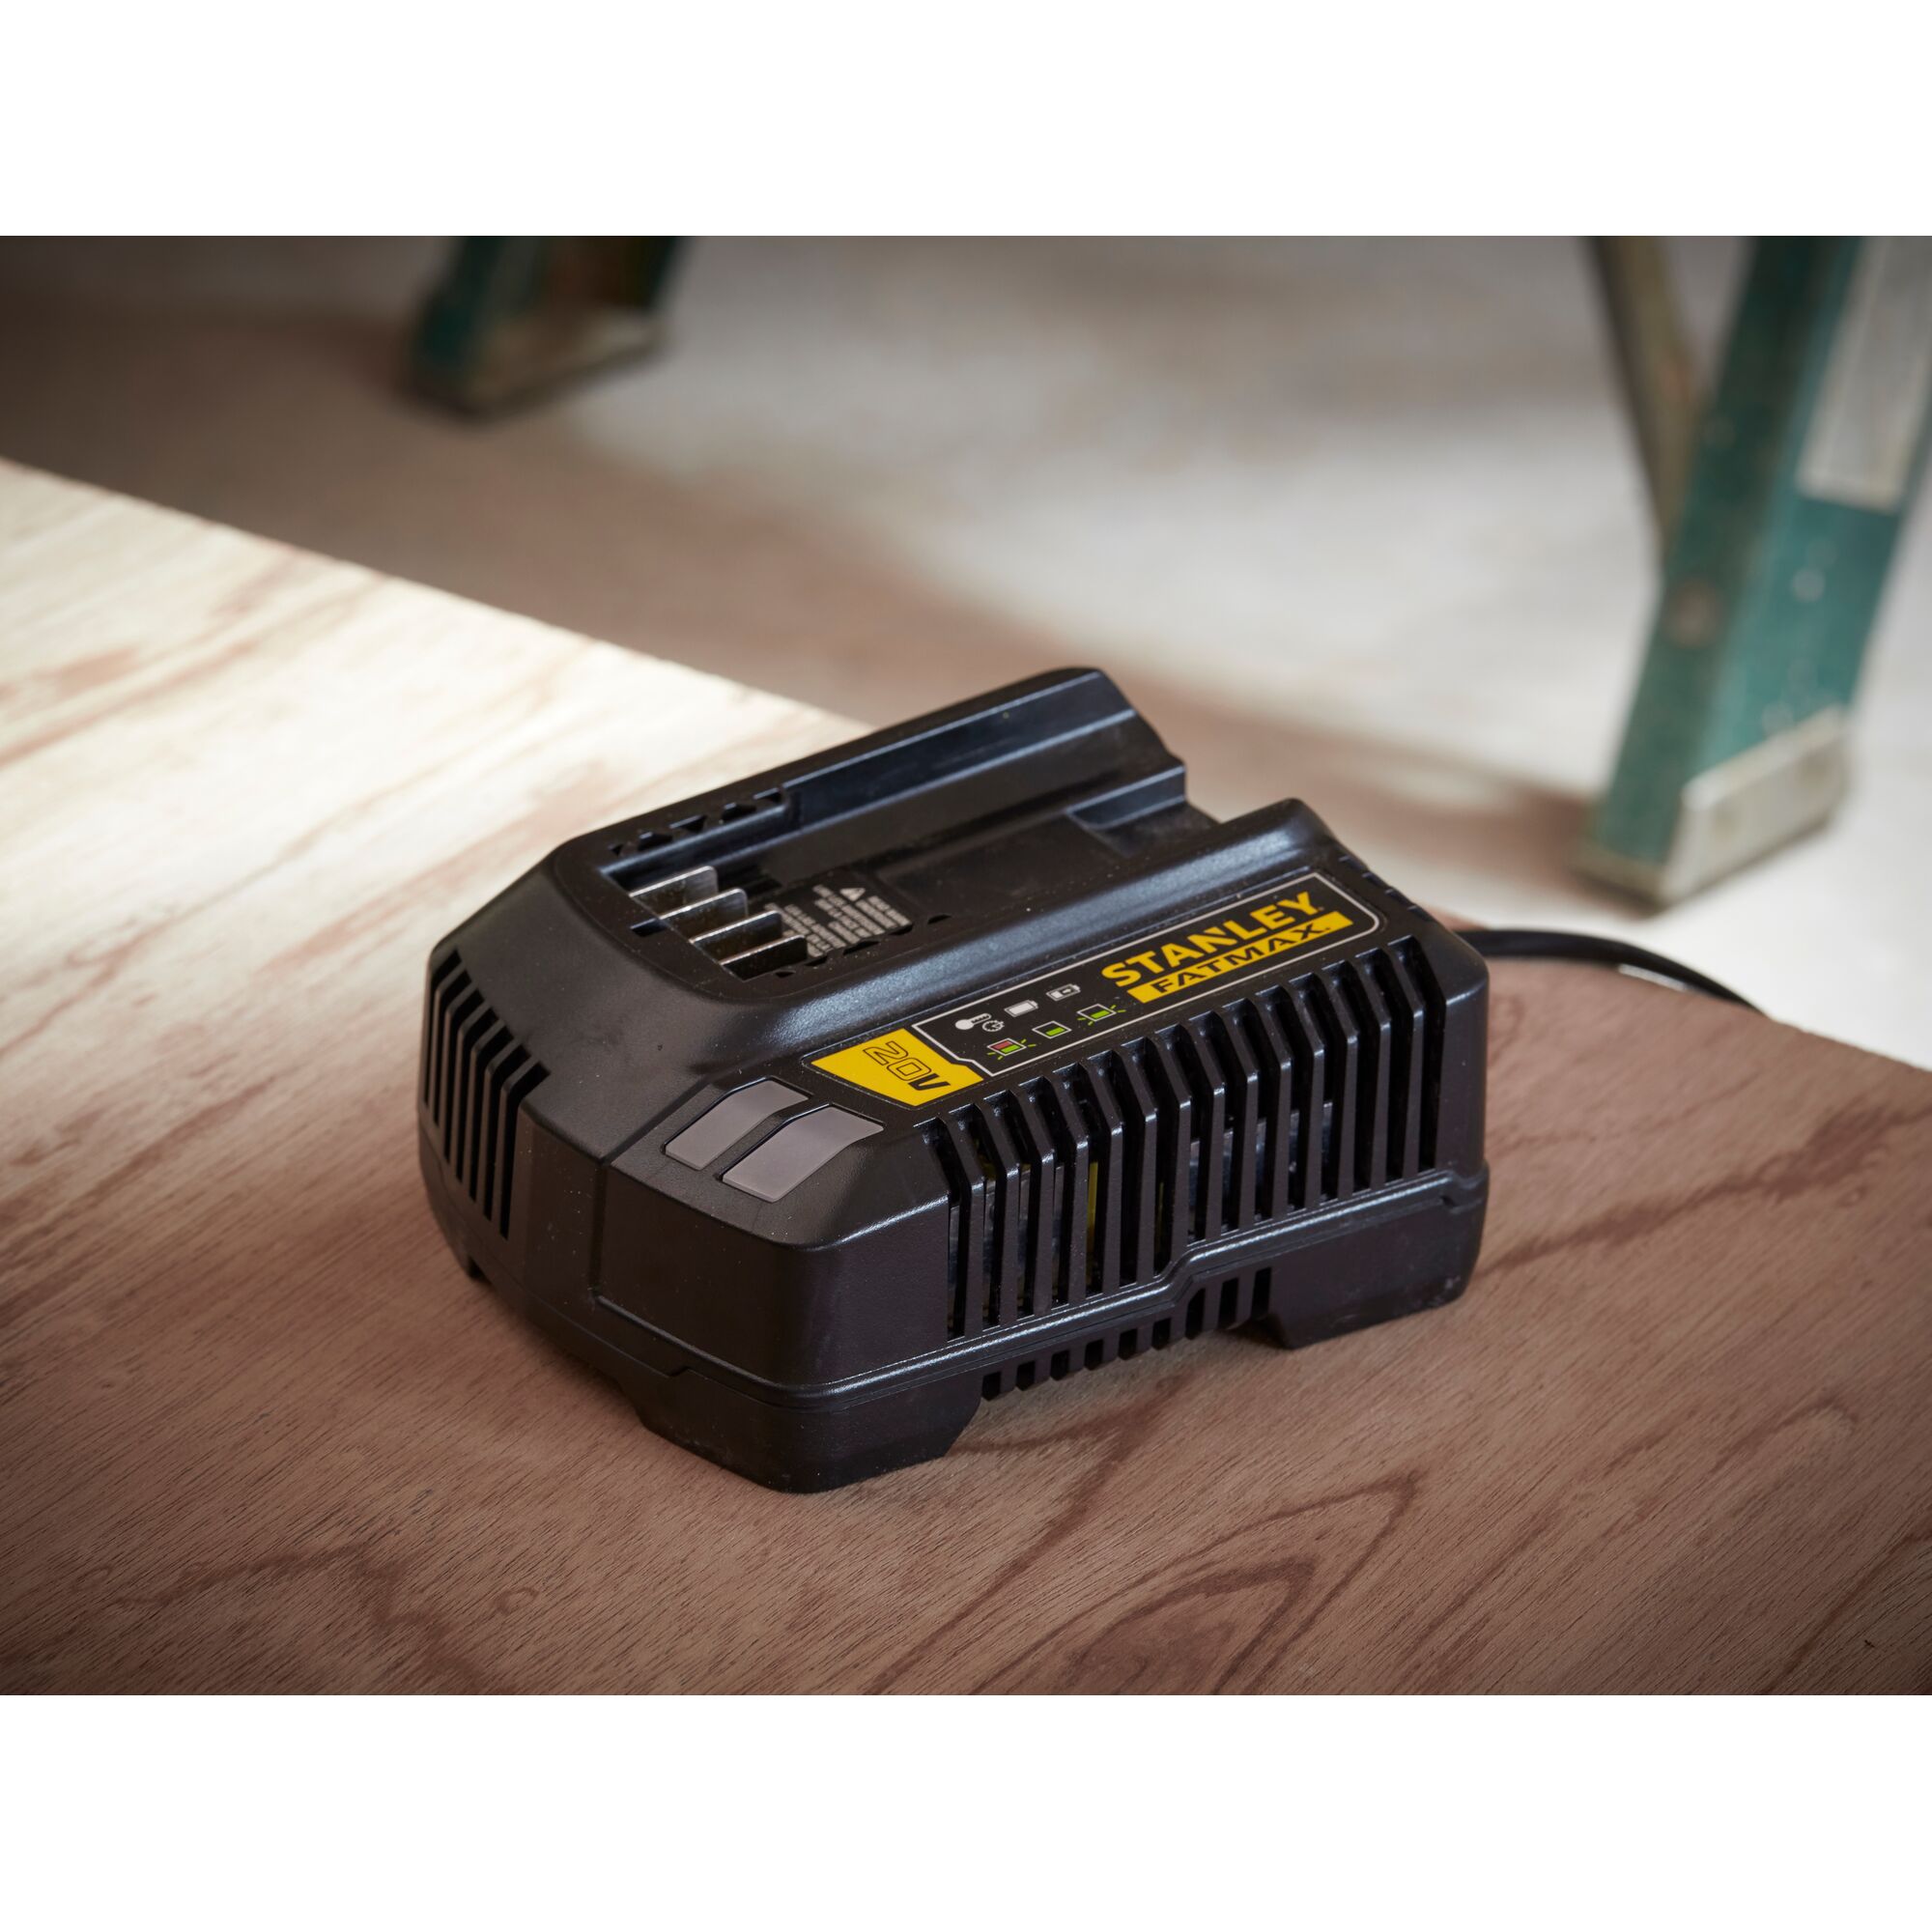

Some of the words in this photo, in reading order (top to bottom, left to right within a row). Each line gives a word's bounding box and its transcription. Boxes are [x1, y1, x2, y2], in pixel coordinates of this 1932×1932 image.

[1101, 891, 1321, 987] STANLEY
[1151, 923, 1323, 994] FATMAX
[863, 1040, 952, 1092] 20V
